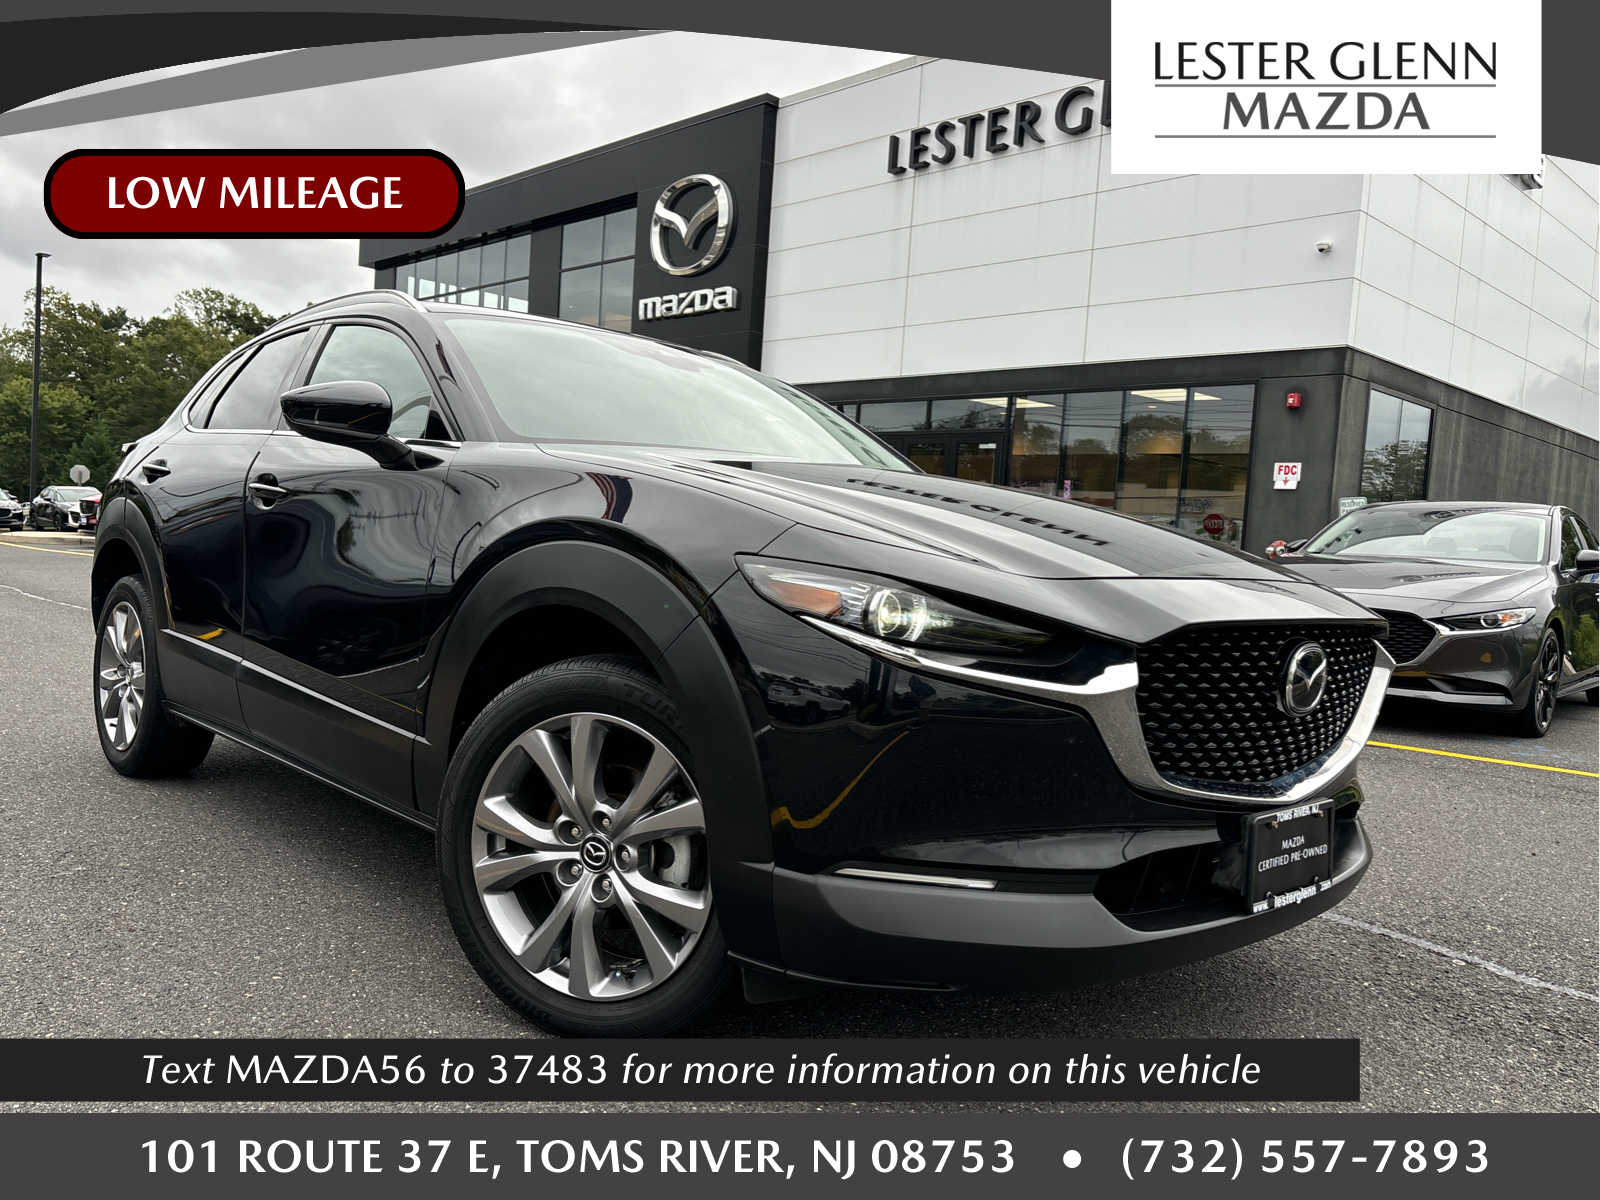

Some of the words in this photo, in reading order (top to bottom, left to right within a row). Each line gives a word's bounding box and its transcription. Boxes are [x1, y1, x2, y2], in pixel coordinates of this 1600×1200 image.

[888, 101, 1045, 175] LESTER
[1277, 464, 1298, 476] FDC
[1281, 835, 1305, 849] MAZDA
[1258, 854, 1289, 872] CERTIFIED
[1290, 844, 1328, 863] PRE-OWNED
